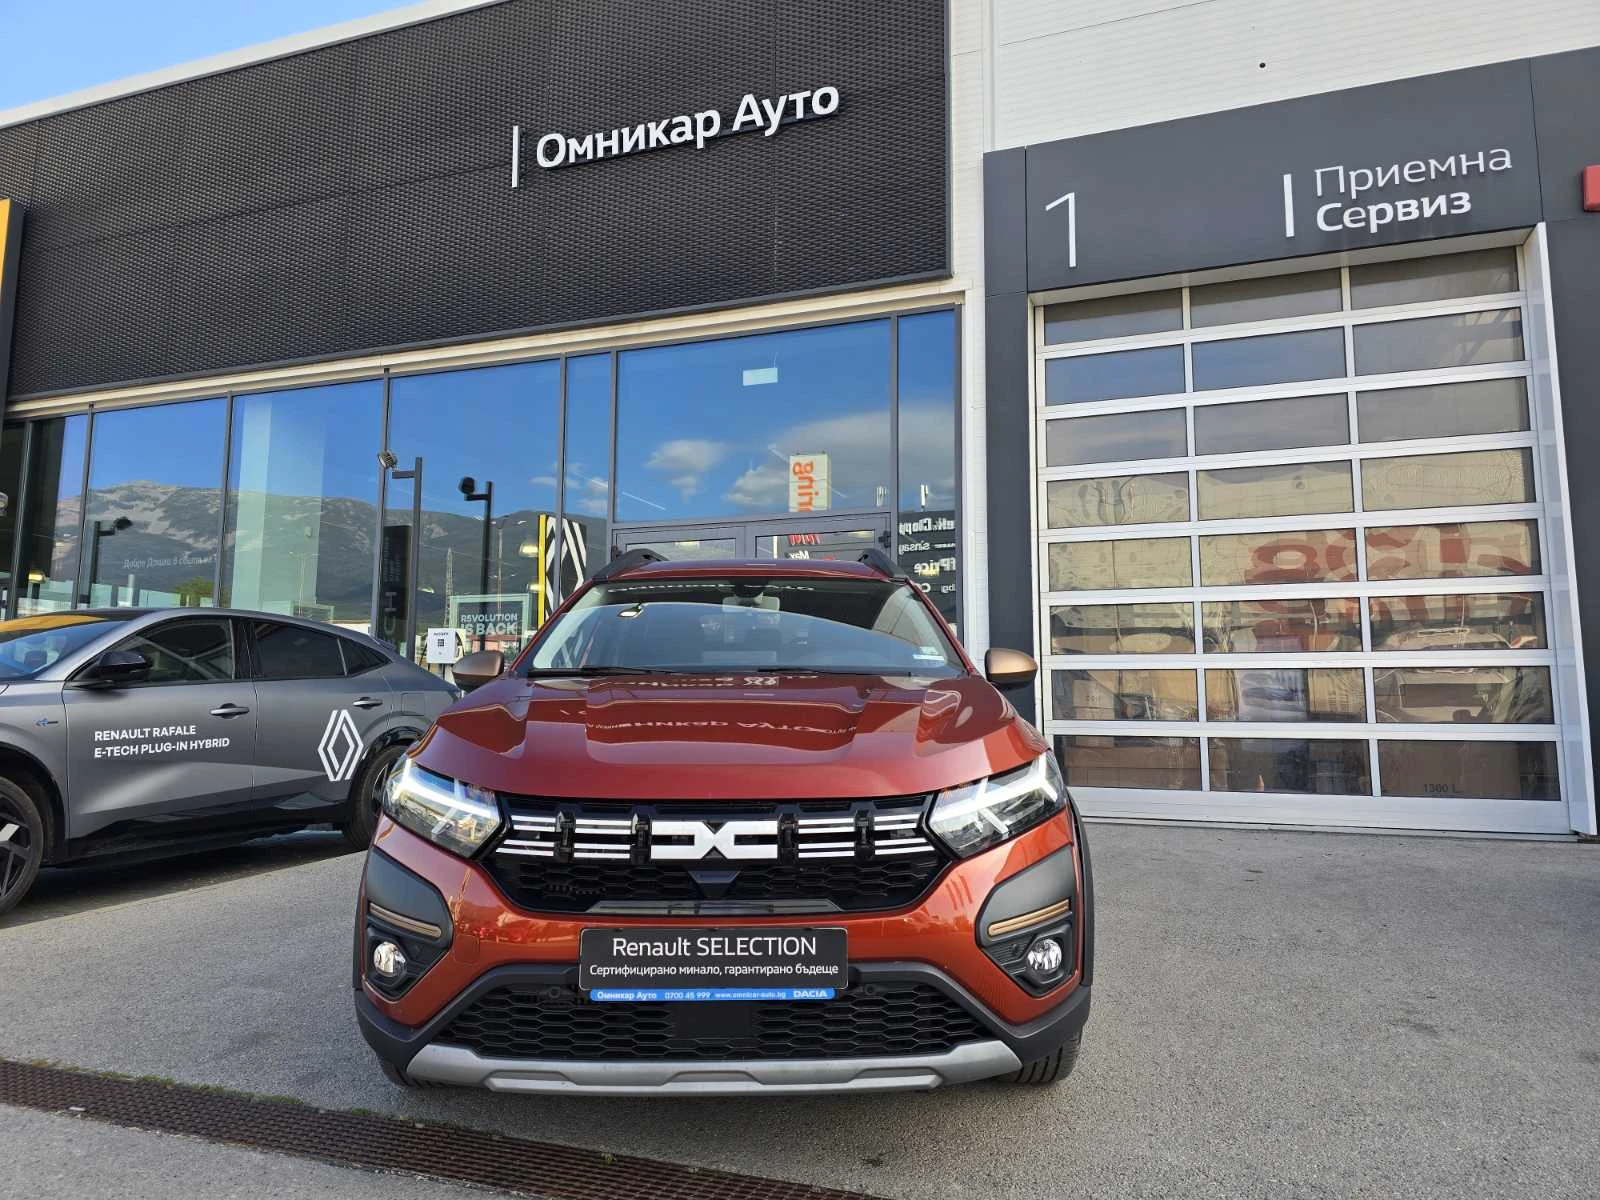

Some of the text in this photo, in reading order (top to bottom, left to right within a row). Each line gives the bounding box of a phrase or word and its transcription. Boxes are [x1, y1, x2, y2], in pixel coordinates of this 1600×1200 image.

[536, 86, 840, 168] Омникар Ауто
[1315, 147, 1512, 199] Приемна
[1315, 190, 1472, 233] Сервиз
[1045, 191, 1077, 268] 1
[461, 613, 518, 622] REVOLUTION
[476, 622, 518, 635] BACK
[94, 725, 197, 741] RENAULT RAFALE
[94, 737, 230, 758] E-TECH PLUG-IN HYBRID
[612, 936, 817, 957] Renault SELECTION
[590, 963, 839, 977] Сертифицирано минало, гарантирано бъдеще
[793, 990, 828, 999] DACIA
